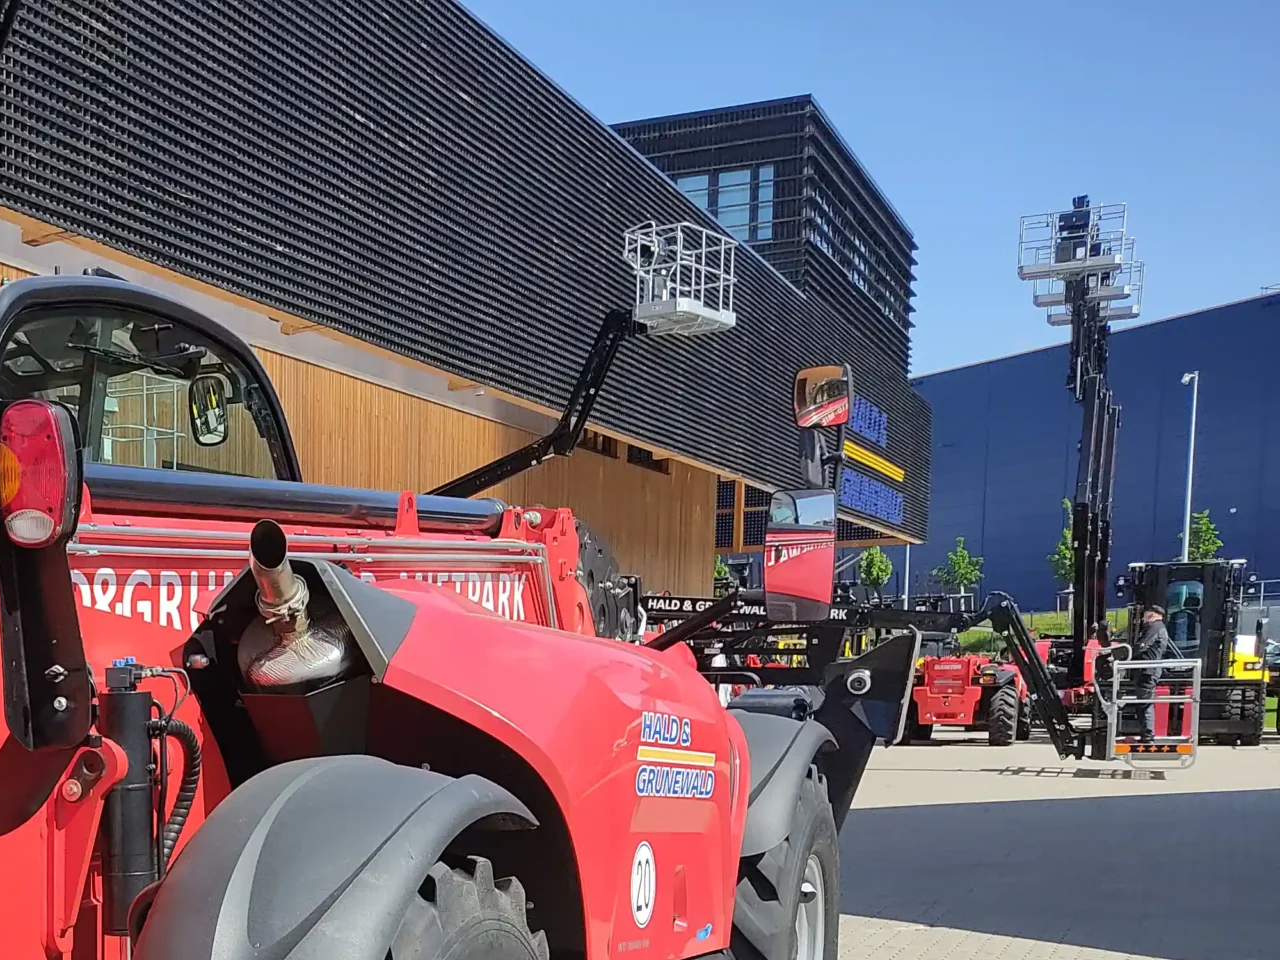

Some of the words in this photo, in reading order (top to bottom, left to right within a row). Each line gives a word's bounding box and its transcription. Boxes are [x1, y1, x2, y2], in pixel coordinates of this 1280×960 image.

[648, 598, 680, 611] HALD
[682, 600, 693, 612] &
[641, 711, 678, 744] HALD
[681, 718, 691, 746] &
[636, 765, 715, 799] GRUNEWALD
[636, 860, 651, 912] 20
